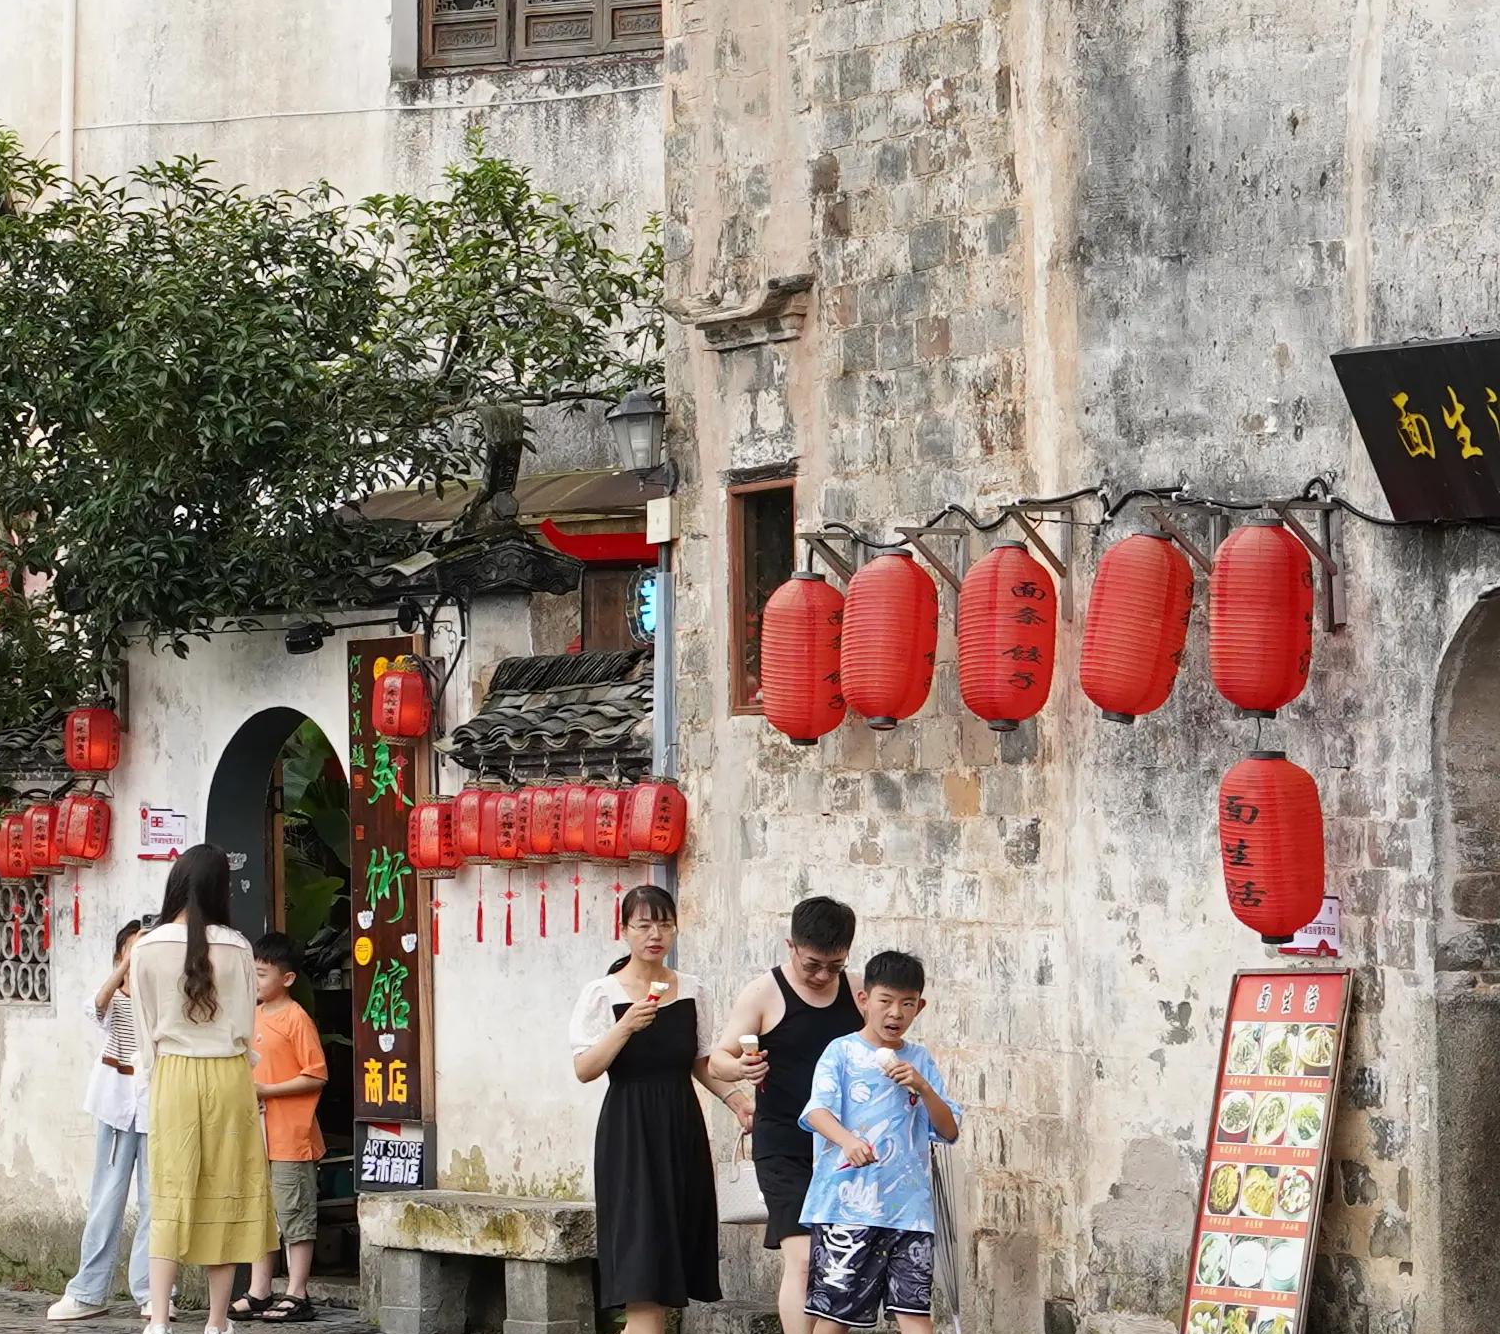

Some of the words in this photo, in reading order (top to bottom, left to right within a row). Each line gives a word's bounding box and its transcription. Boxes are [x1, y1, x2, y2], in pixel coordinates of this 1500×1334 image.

[1221, 795, 1268, 909] 面生活
[1257, 983, 1319, 1014] 面生活
[363, 1057, 408, 1108] 商店
[361, 1139, 385, 1157] ART
[386, 1140, 422, 1159] STORE
[361, 1156, 420, 1185] 艺术商店
